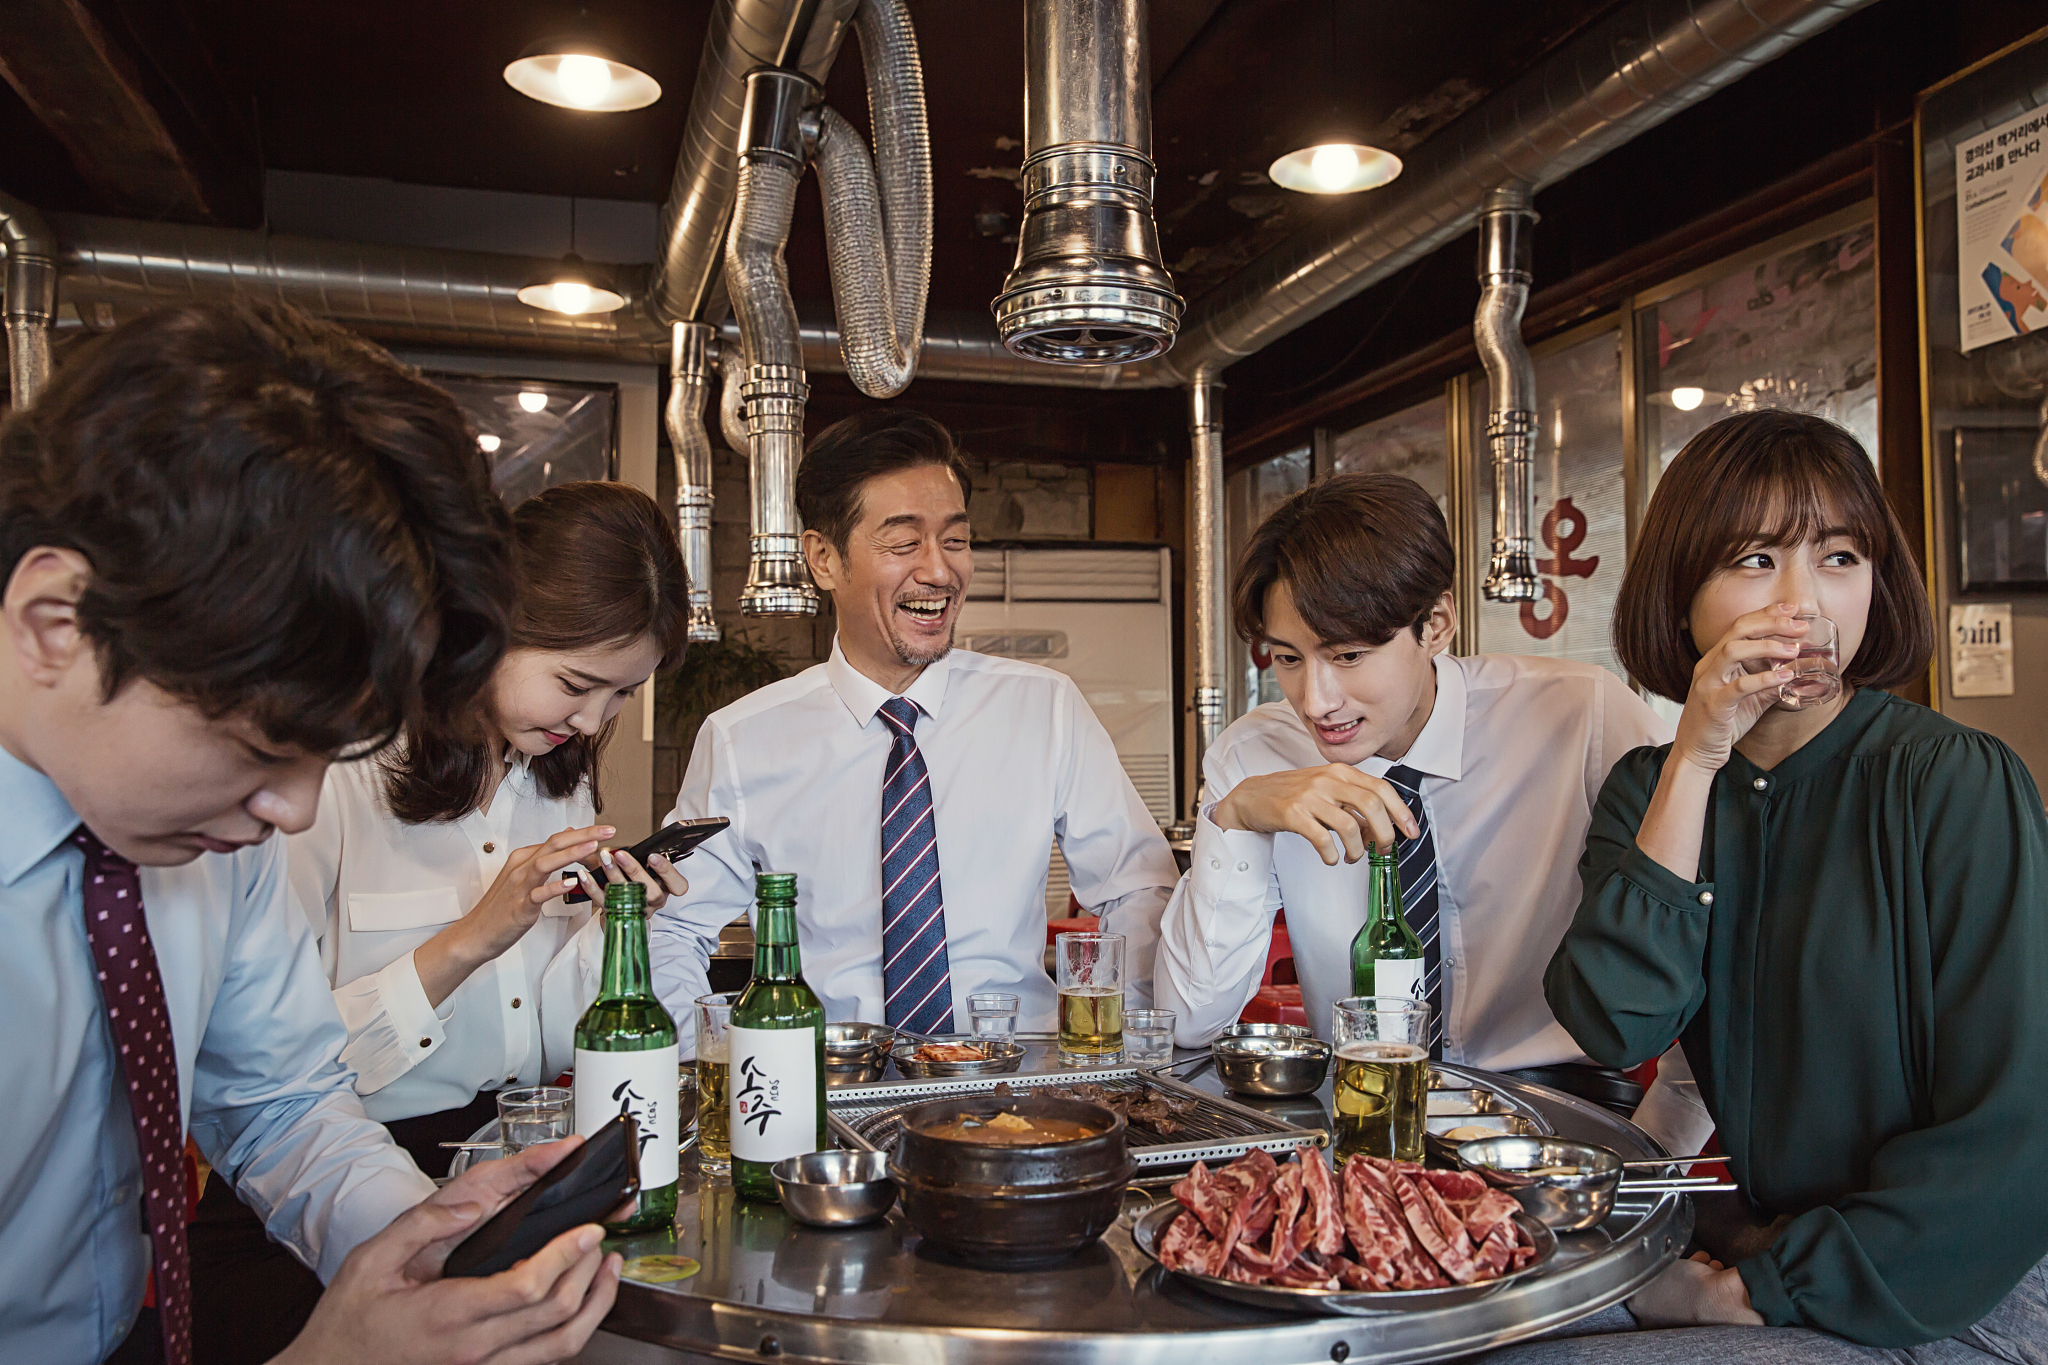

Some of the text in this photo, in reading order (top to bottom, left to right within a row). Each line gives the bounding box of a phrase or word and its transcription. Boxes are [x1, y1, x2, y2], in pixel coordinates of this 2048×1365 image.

[1965, 139, 1993, 164] 경의선
[1965, 138, 2040, 182] 교과서를 만나다
[736, 1055, 782, 1137] 소주
